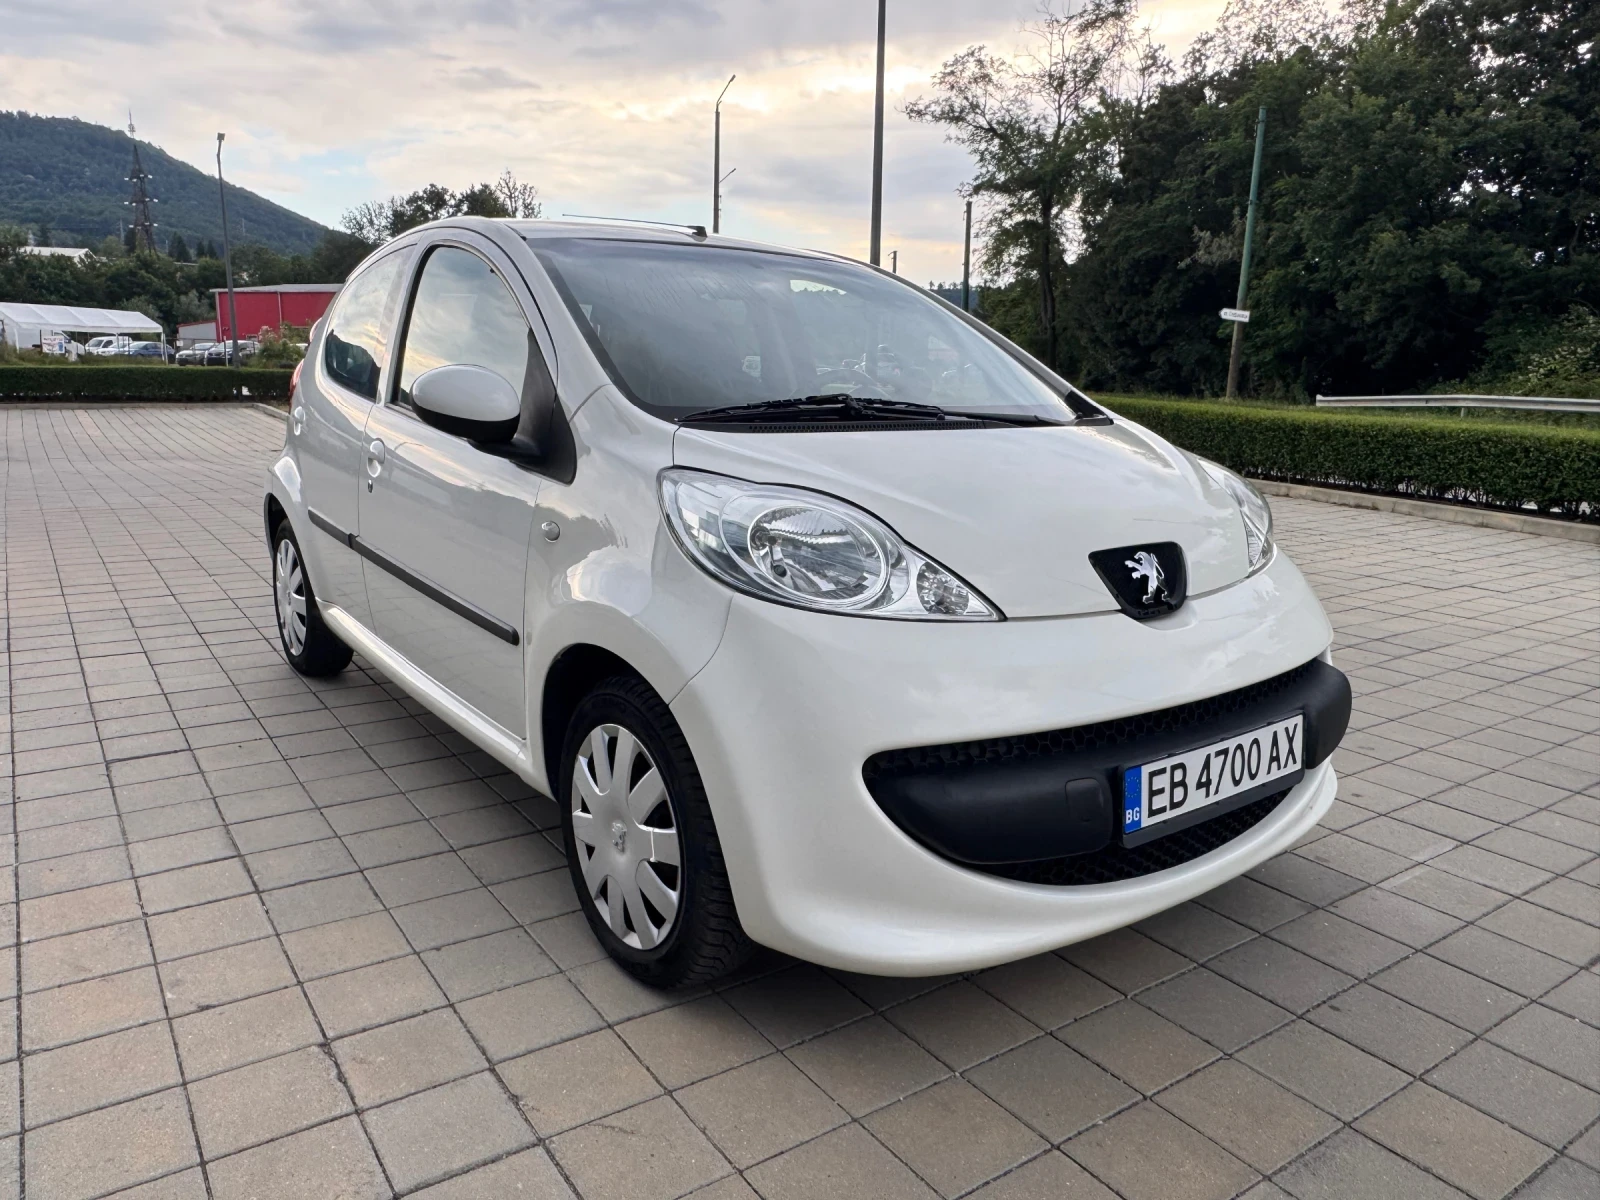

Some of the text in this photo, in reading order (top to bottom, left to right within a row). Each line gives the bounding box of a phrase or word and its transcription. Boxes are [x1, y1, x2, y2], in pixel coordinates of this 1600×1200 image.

[1148, 723, 1298, 818] EB 4700 AX
[1125, 807, 1140, 824] BG
